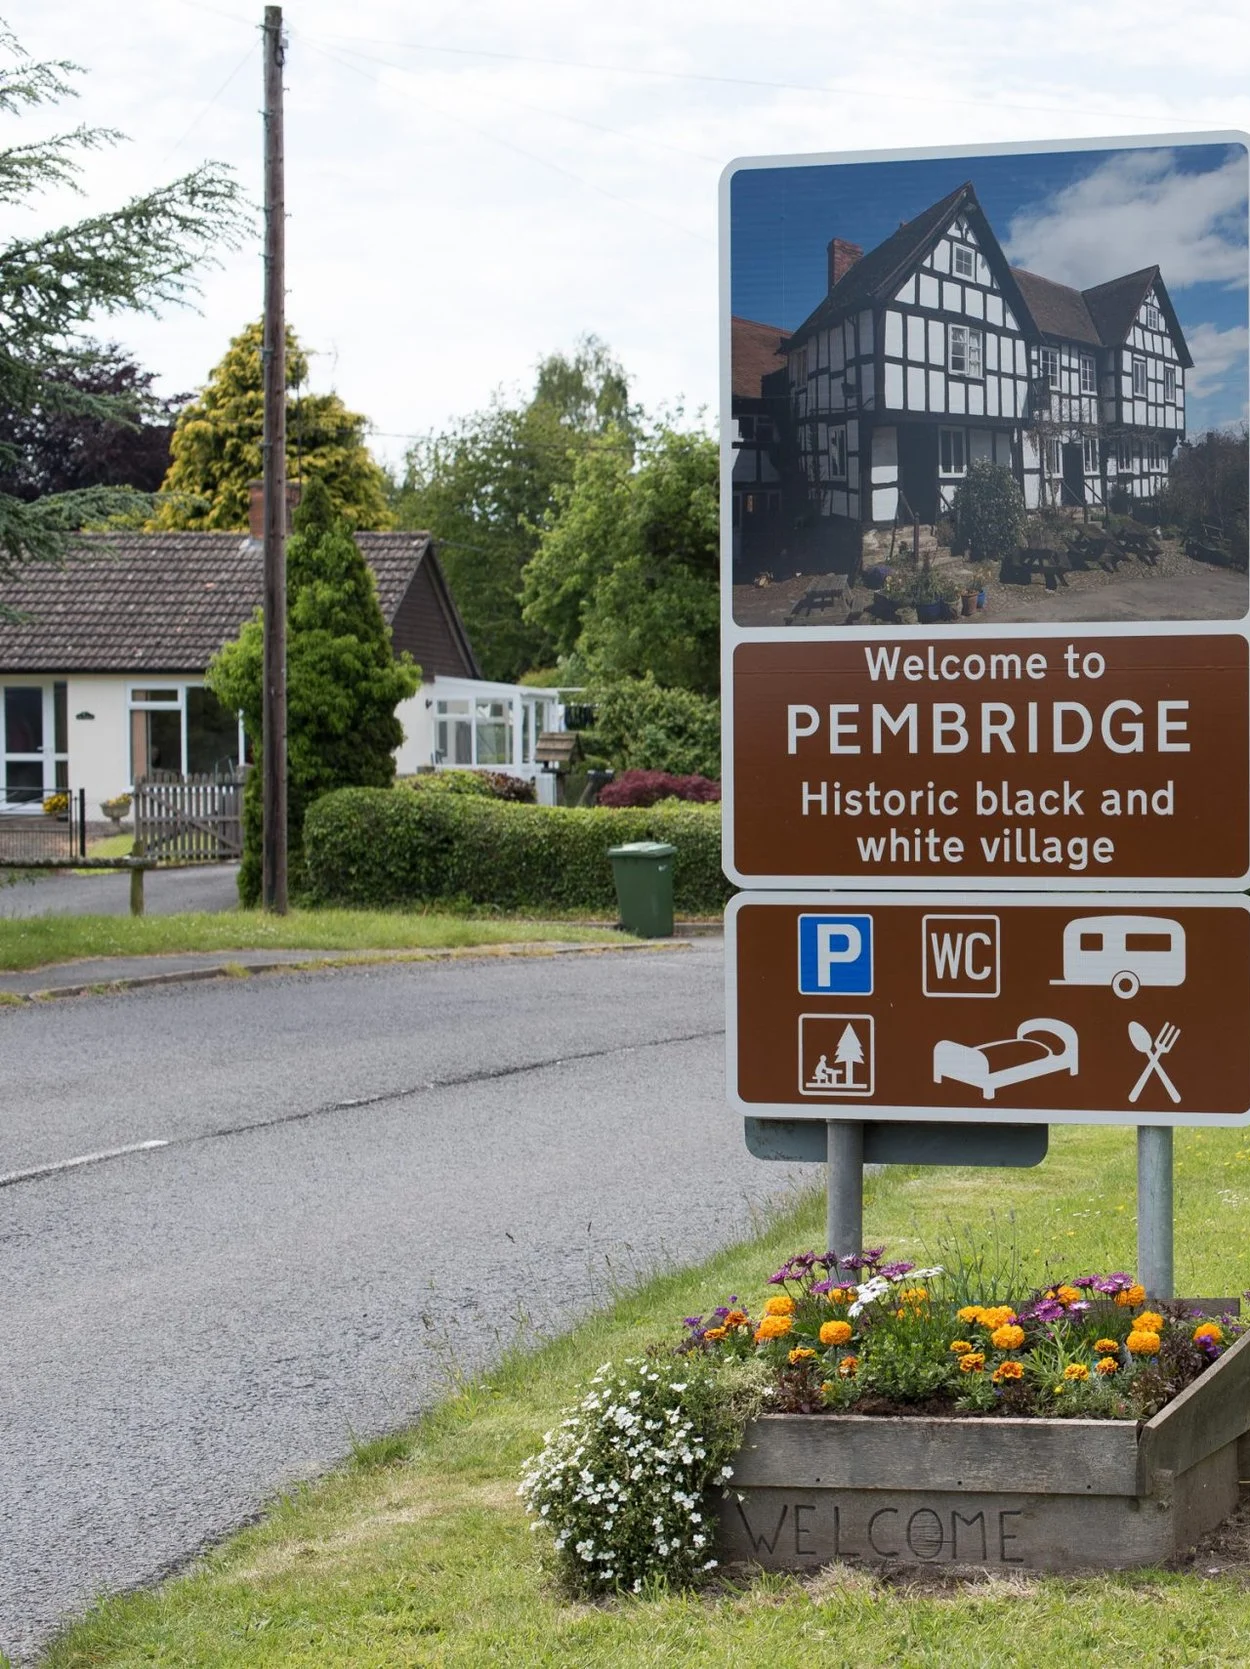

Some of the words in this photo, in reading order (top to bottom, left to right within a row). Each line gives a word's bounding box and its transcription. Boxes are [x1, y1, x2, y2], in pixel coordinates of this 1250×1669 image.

[864, 646, 1047, 681] Welcome
[1064, 644, 1106, 679] to
[787, 699, 1191, 755] PEMBRIDGE
[802, 781, 959, 817] Historic
[976, 780, 1085, 816] black
[1100, 780, 1174, 816] and
[856, 827, 965, 863] white
[980, 827, 1115, 871] village
[817, 923, 862, 987] P
[930, 932, 992, 981] WC
[736, 1503, 1025, 1564] WELCOME
